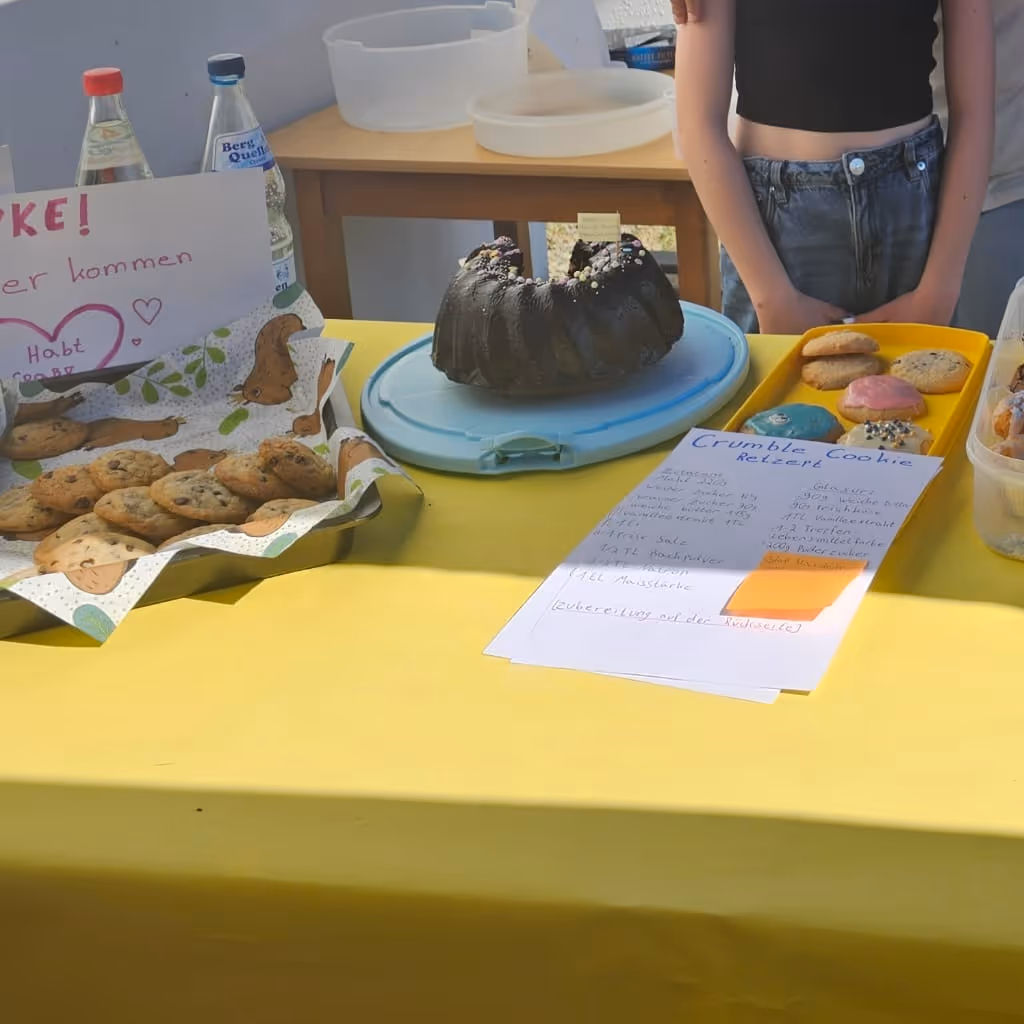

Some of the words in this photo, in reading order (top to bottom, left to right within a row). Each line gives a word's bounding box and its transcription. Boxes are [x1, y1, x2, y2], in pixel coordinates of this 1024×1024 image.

[222, 139, 256, 153] Berg
[0, 193, 91, 238] KE!
[68, 251, 193, 283] kommen
[28, 338, 85, 364] Habt
[691, 433, 806, 455] Crumble
[826, 447, 913, 468] Cookie
